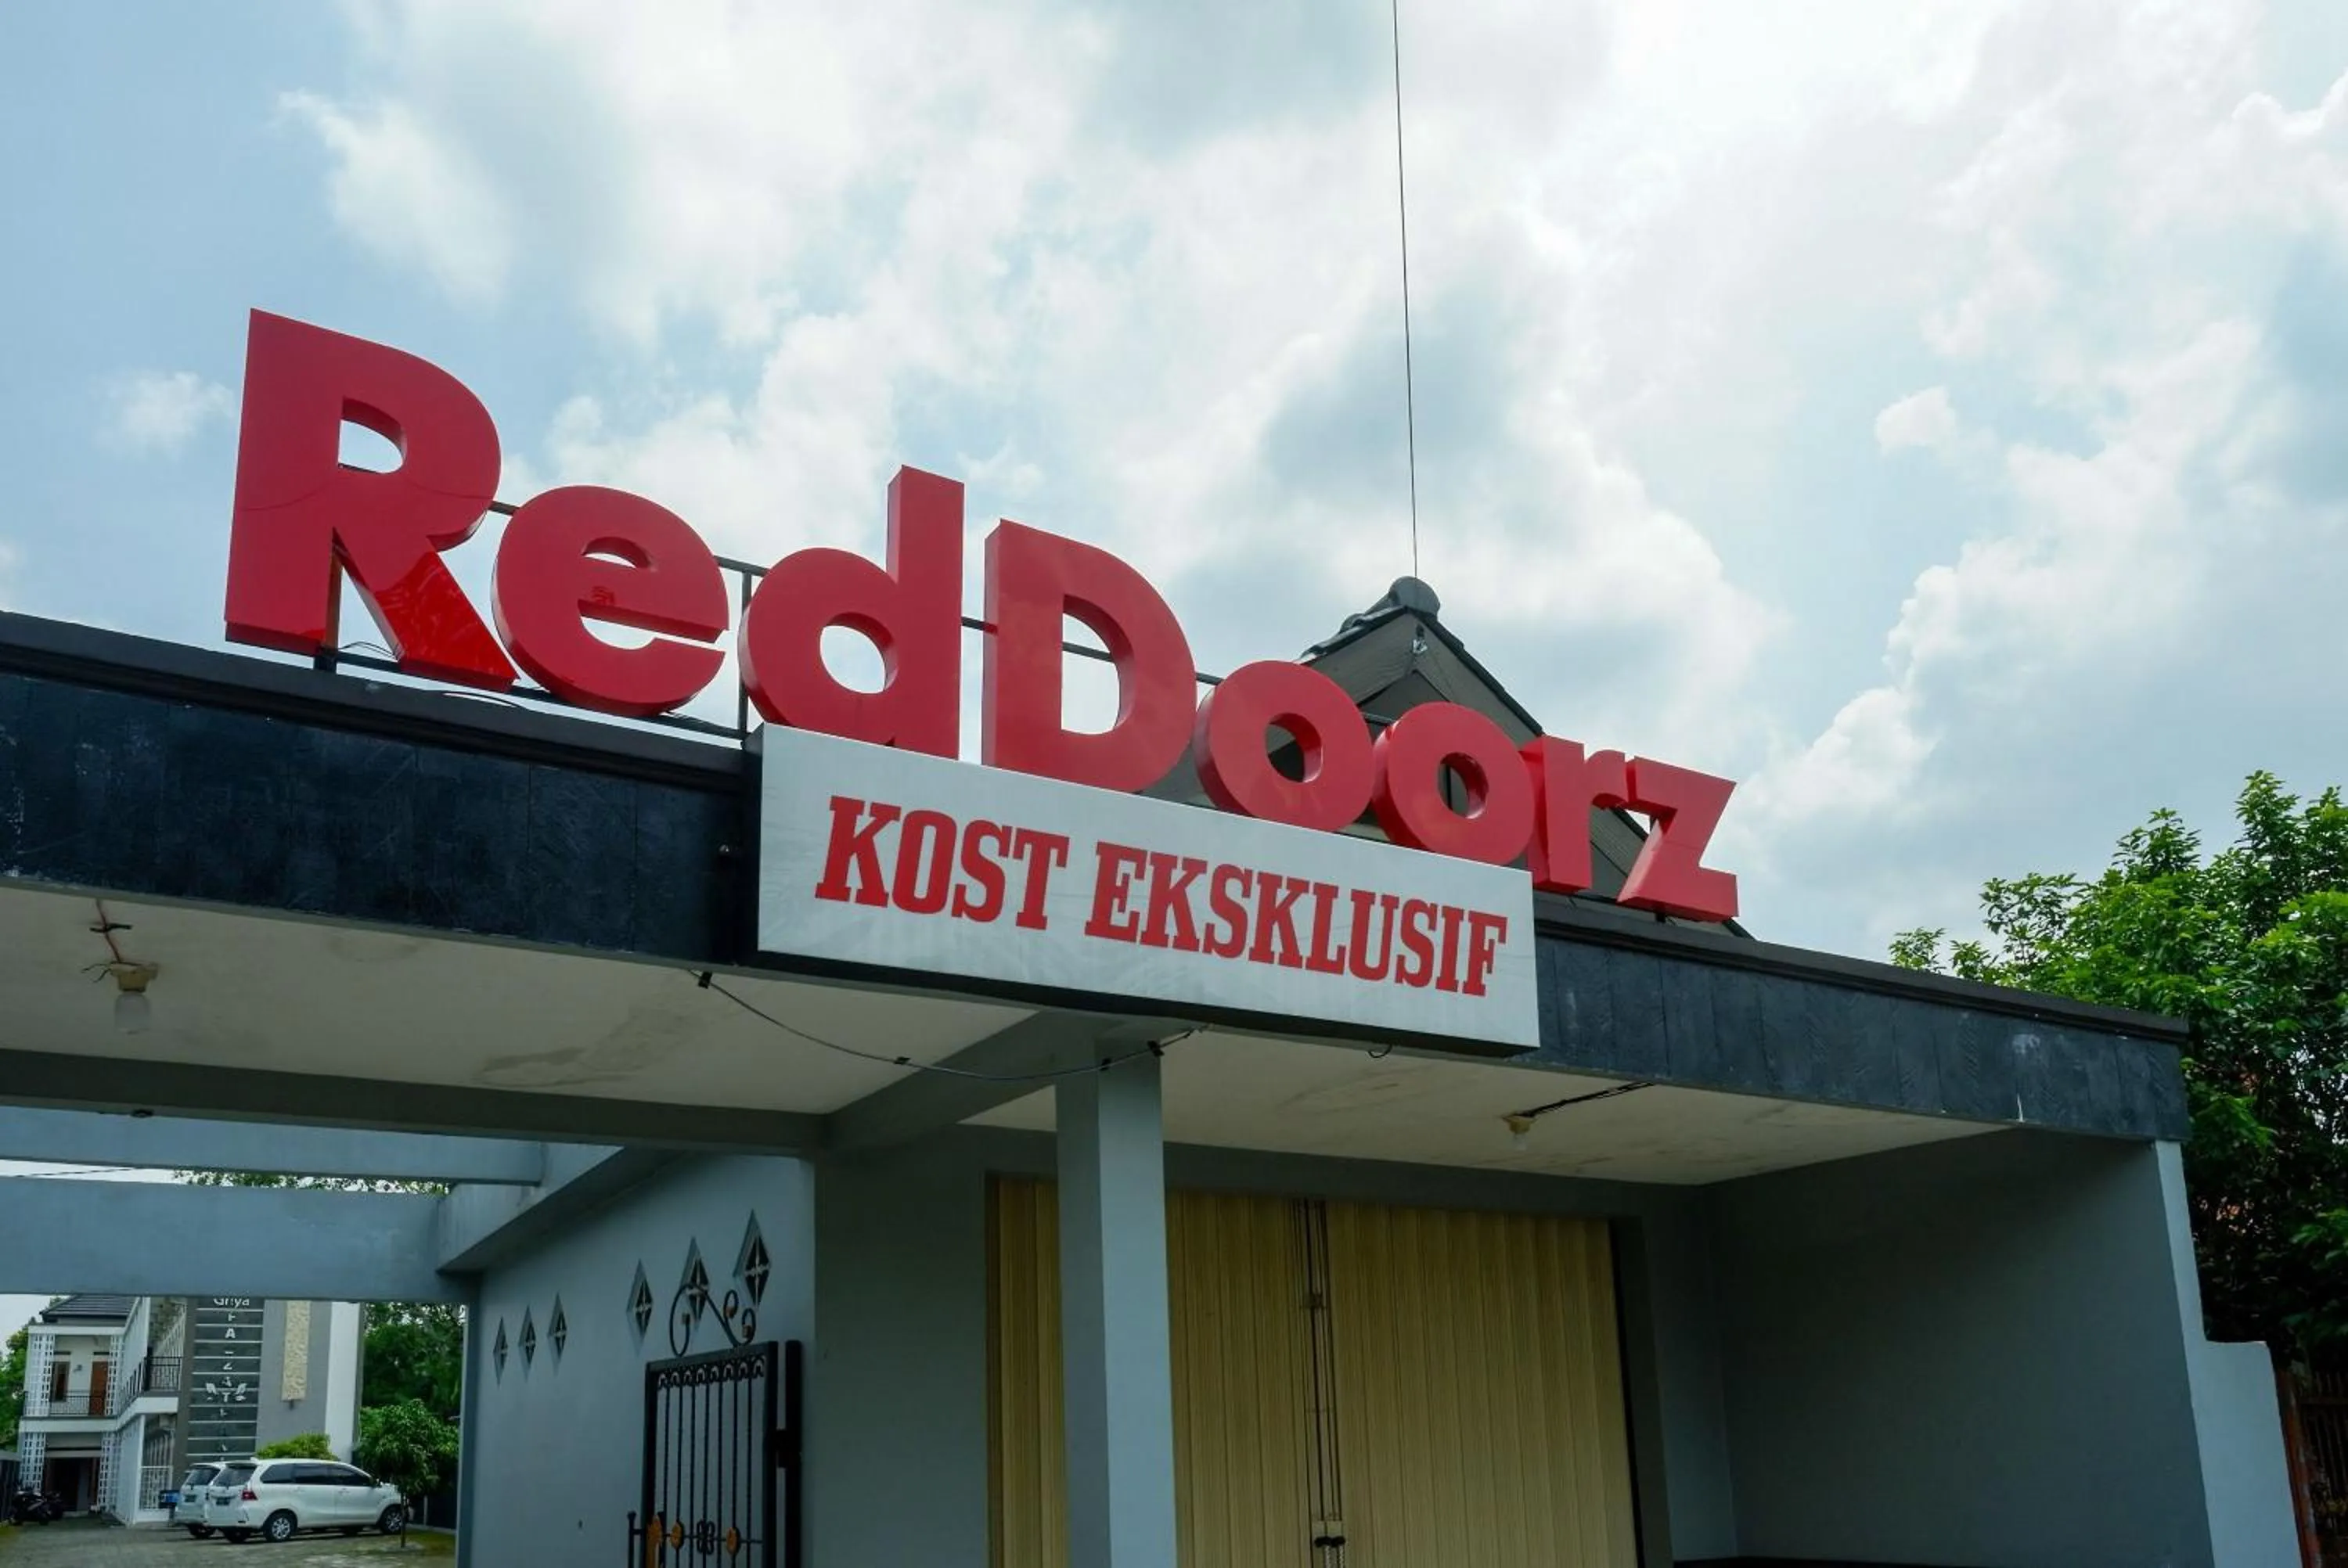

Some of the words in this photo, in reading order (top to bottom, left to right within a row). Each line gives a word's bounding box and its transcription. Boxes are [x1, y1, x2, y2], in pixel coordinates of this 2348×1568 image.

[225, 308, 1739, 922] RedDoorz
[815, 795, 1070, 930] KOST
[1085, 841, 1507, 997] EKSKLUSIF
